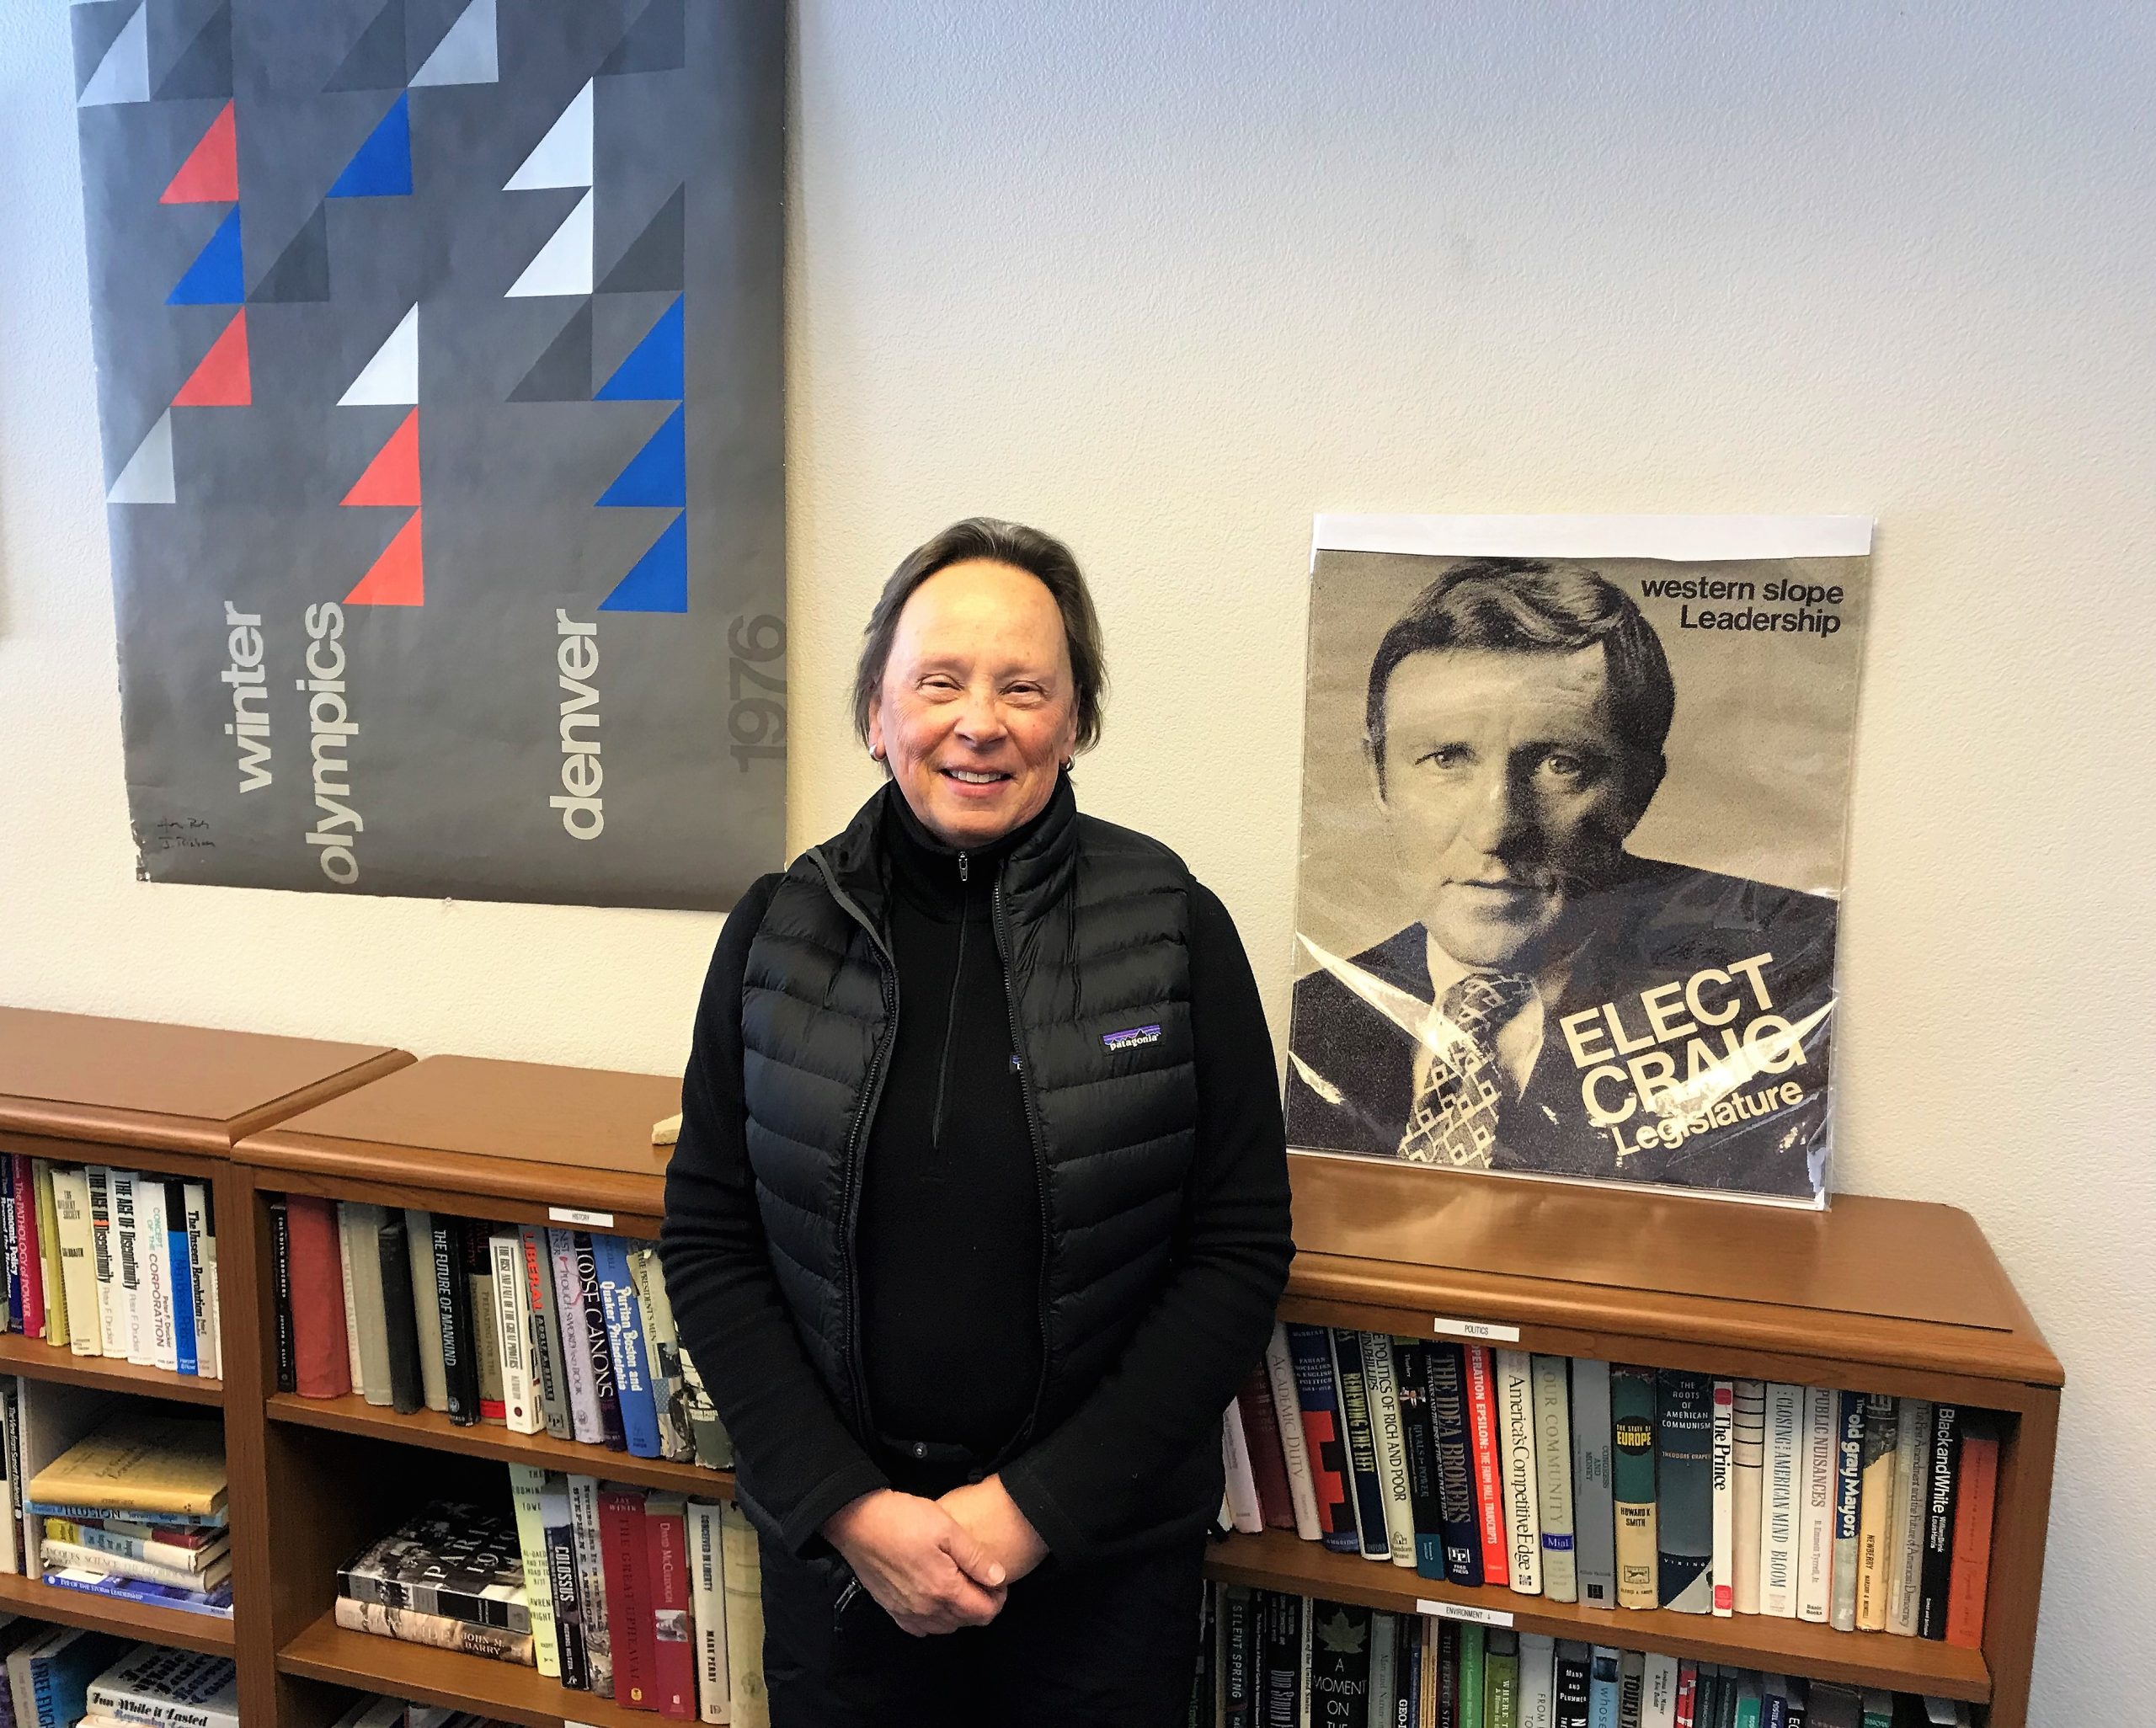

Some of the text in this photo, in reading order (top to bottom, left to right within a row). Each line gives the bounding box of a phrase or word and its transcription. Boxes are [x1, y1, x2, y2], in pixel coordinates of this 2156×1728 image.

[1641, 576, 1844, 606] western slope
[1680, 605, 1841, 637] Leadership
[221, 600, 272, 793] winter
[727, 614, 787, 773] 1976
[296, 601, 363, 885] olympics
[549, 608, 604, 840] denver
[1560, 952, 1773, 1069] ELECT
[1109, 1034, 1158, 1051] patagonia
[1582, 1015, 1807, 1123] CRAIG
[1611, 1080, 1804, 1156] Legislature
[7, 1197, 17, 1244] Economic
[90, 1191, 107, 1208] AGE
[572, 1213, 590, 1222] HISTORY
[17, 1202, 30, 1317] PATHOLOGY POWER
[93, 1225, 114, 1284] Discontinuity
[115, 1180, 140, 1290] THE AGE OF Discontinuity
[188, 1211, 205, 1316] The Unseen Revolution
[149, 1254, 164, 1347] CORPORATION
[433, 1229, 456, 1366] THE FUTURE OF MANKIND
[523, 1232, 543, 1313] LIBERAL
[507, 1342, 519, 1369] POWERS
[584, 1308, 614, 1398] CANONS
[600, 1281, 616, 1321] Quaker
[608, 1323, 627, 1390] Philadelphia
[616, 1286, 643, 1390] Puritan Boston and
[648, 1322, 657, 1341] MEN
[1465, 1325, 1488, 1335] POLITICS
[574, 1367, 582, 1395] BOOK
[1364, 1348, 1379, 1390] PHILLIPS
[1673, 1390, 1700, 1400] ROOTS
[1271, 1354, 1305, 1479] ACADEMIC DUTY
[1343, 1373, 1375, 1473] RENEWING THE LEFT
[1374, 1342, 1407, 1501] POLITICS OF RICH AND POOR
[1432, 1354, 1470, 1523] THE IDEA BROKERS
[1616, 1432, 1652, 1447] EUROPE
[1662, 1420, 1710, 1429] COMMUNISM
[1666, 1411, 1708, 1420] AMERICAN
[1476, 1403, 1497, 1544] EPSILON: THE FARM HALL TRANSCRIPTS
[1543, 1373, 1564, 1524] OUR COMMUNITY
[1601, 1445, 1609, 1488] CONGRESS
[1714, 1413, 1731, 1491] The Prince
[1771, 1398, 1794, 1543] CLOSING AMERICAN MIND
[1812, 1389, 1829, 1507] PUBLIC NUISANCES
[1838, 1399, 1865, 1537] The old gray Mayors
[1933, 1407, 1955, 1513] Black and White
[1510, 1446, 1530, 1532] Competitive
[1620, 1507, 1645, 1517] HOWARD
[573, 1487, 586, 1549] STEPHEN
[1625, 1517, 1646, 1527] SMITH
[555, 1545, 574, 1602] COLOSSUS
[1515, 1533, 1534, 1571] Edge
[1770, 1550, 1787, 1587] BLOOM
[1865, 1534, 1876, 1570] NEWBERRY
[619, 1518, 639, 1679] THE GREAT UPHEAVAL
[1446, 1607, 1482, 1619] ENVIRONMENT
[462, 1632, 489, 1644] JOHN
[465, 1642, 501, 1656] BARRY
[706, 1630, 717, 1683] MARK PERRY
[1231, 1605, 1242, 1699] SILENT SPRING
[1335, 1658, 1344, 1672] A
[1313, 1675, 1368, 1694] MOMENT
[1327, 1700, 1349, 1716] ON
[1442, 1660, 1451, 1705] PERFECT
[1502, 1680, 1510, 1719] WHERE
[1537, 1693, 1545, 1722] FROM
[1622, 1674, 1641, 1717] TOUCH
